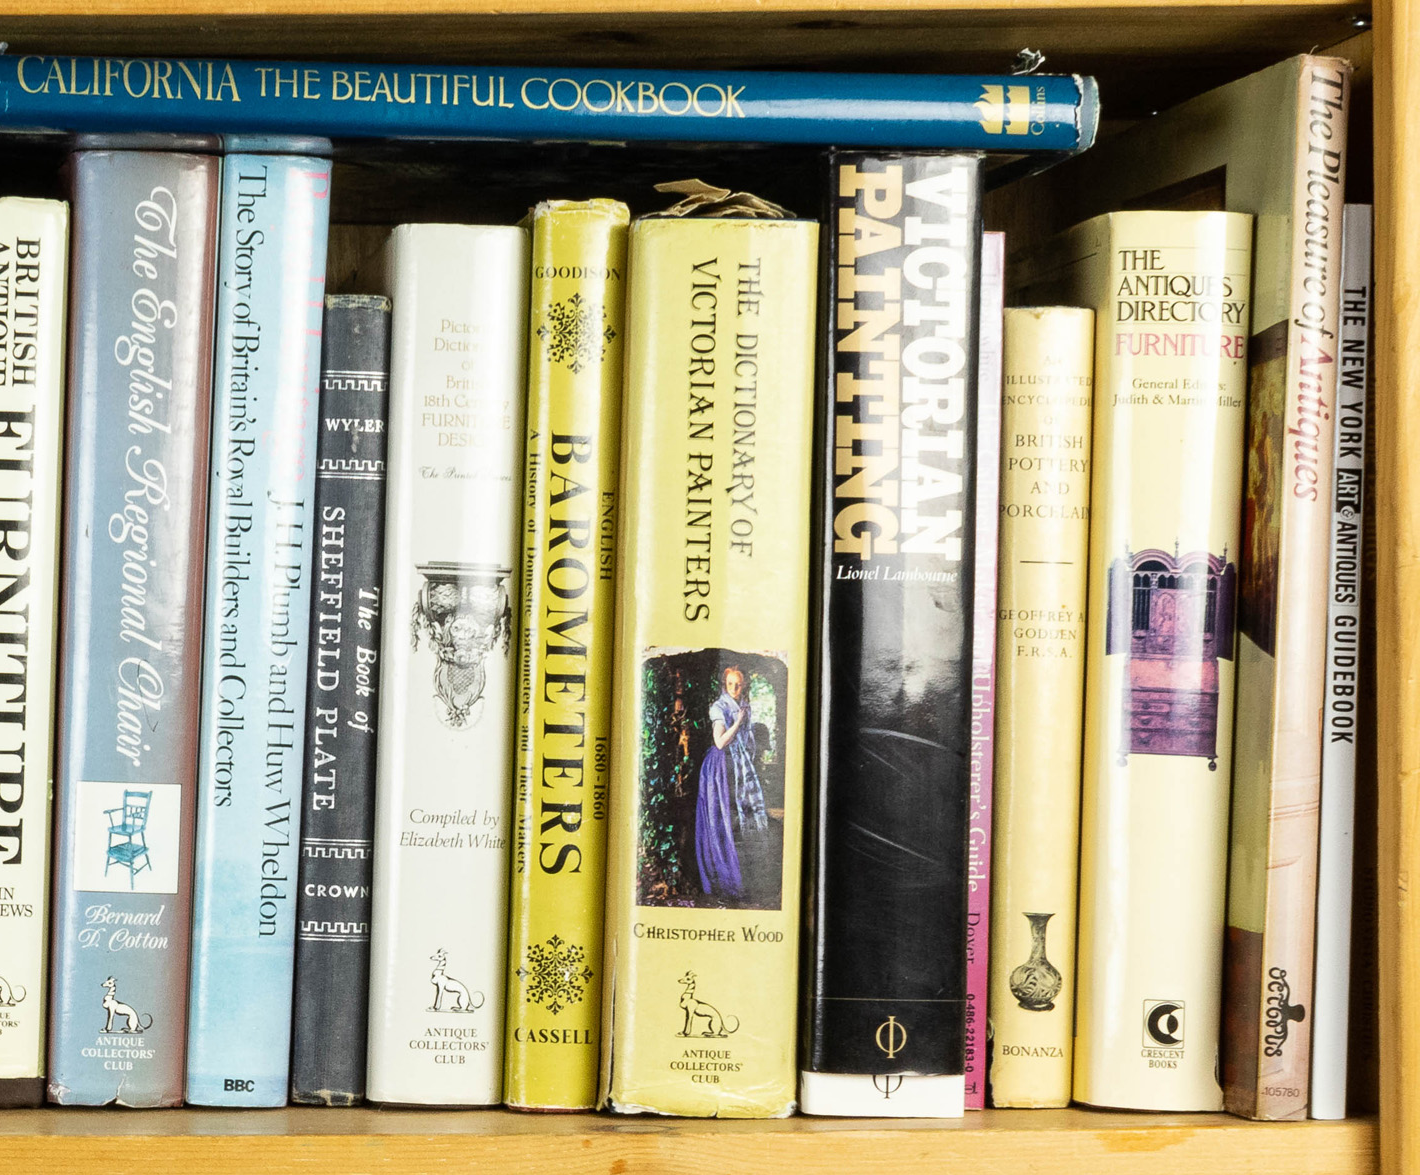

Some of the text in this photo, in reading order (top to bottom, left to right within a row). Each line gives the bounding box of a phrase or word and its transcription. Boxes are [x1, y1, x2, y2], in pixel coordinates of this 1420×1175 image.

[17, 55, 745, 118] CALIFORNIA THE BEAUTIFUL COOKBOOK
[535, 267, 621, 280] GOODISON
[11, 237, 41, 387] BRITISH
[834, 165, 903, 560] PAINTING
[901, 165, 968, 561] VICTORIAN
[726, 258, 761, 557] THE DICTIONARY OF
[326, 418, 384, 432] WYLER
[683, 257, 718, 622] VICTORIAN PAINTERS
[1331, 286, 1366, 744] THE NEW YORK ART ANTIQUES GUIDEBOOK
[836, 565, 957, 583] Lionel Lambourne
[312, 507, 345, 811] SHEFFIELD PLATE
[539, 431, 592, 874] BAROMETERS
[409, 809, 499, 828] Compiled by
[399, 832, 505, 849] Elizabeth White
[305, 884, 368, 897] CROWN
[84, 905, 163, 926] Bernard
[108, 928, 168, 950] Cotton
[634, 924, 783, 942] CHRISTOPHER WOOD
[514, 1028, 592, 1045] CASSELL
[1002, 1045, 1063, 1058] BONANZA
[1141, 1050, 1184, 1059] CRESCENT
[1149, 1060, 1177, 1068] BOOKS
[224, 1079, 254, 1092] BBC
